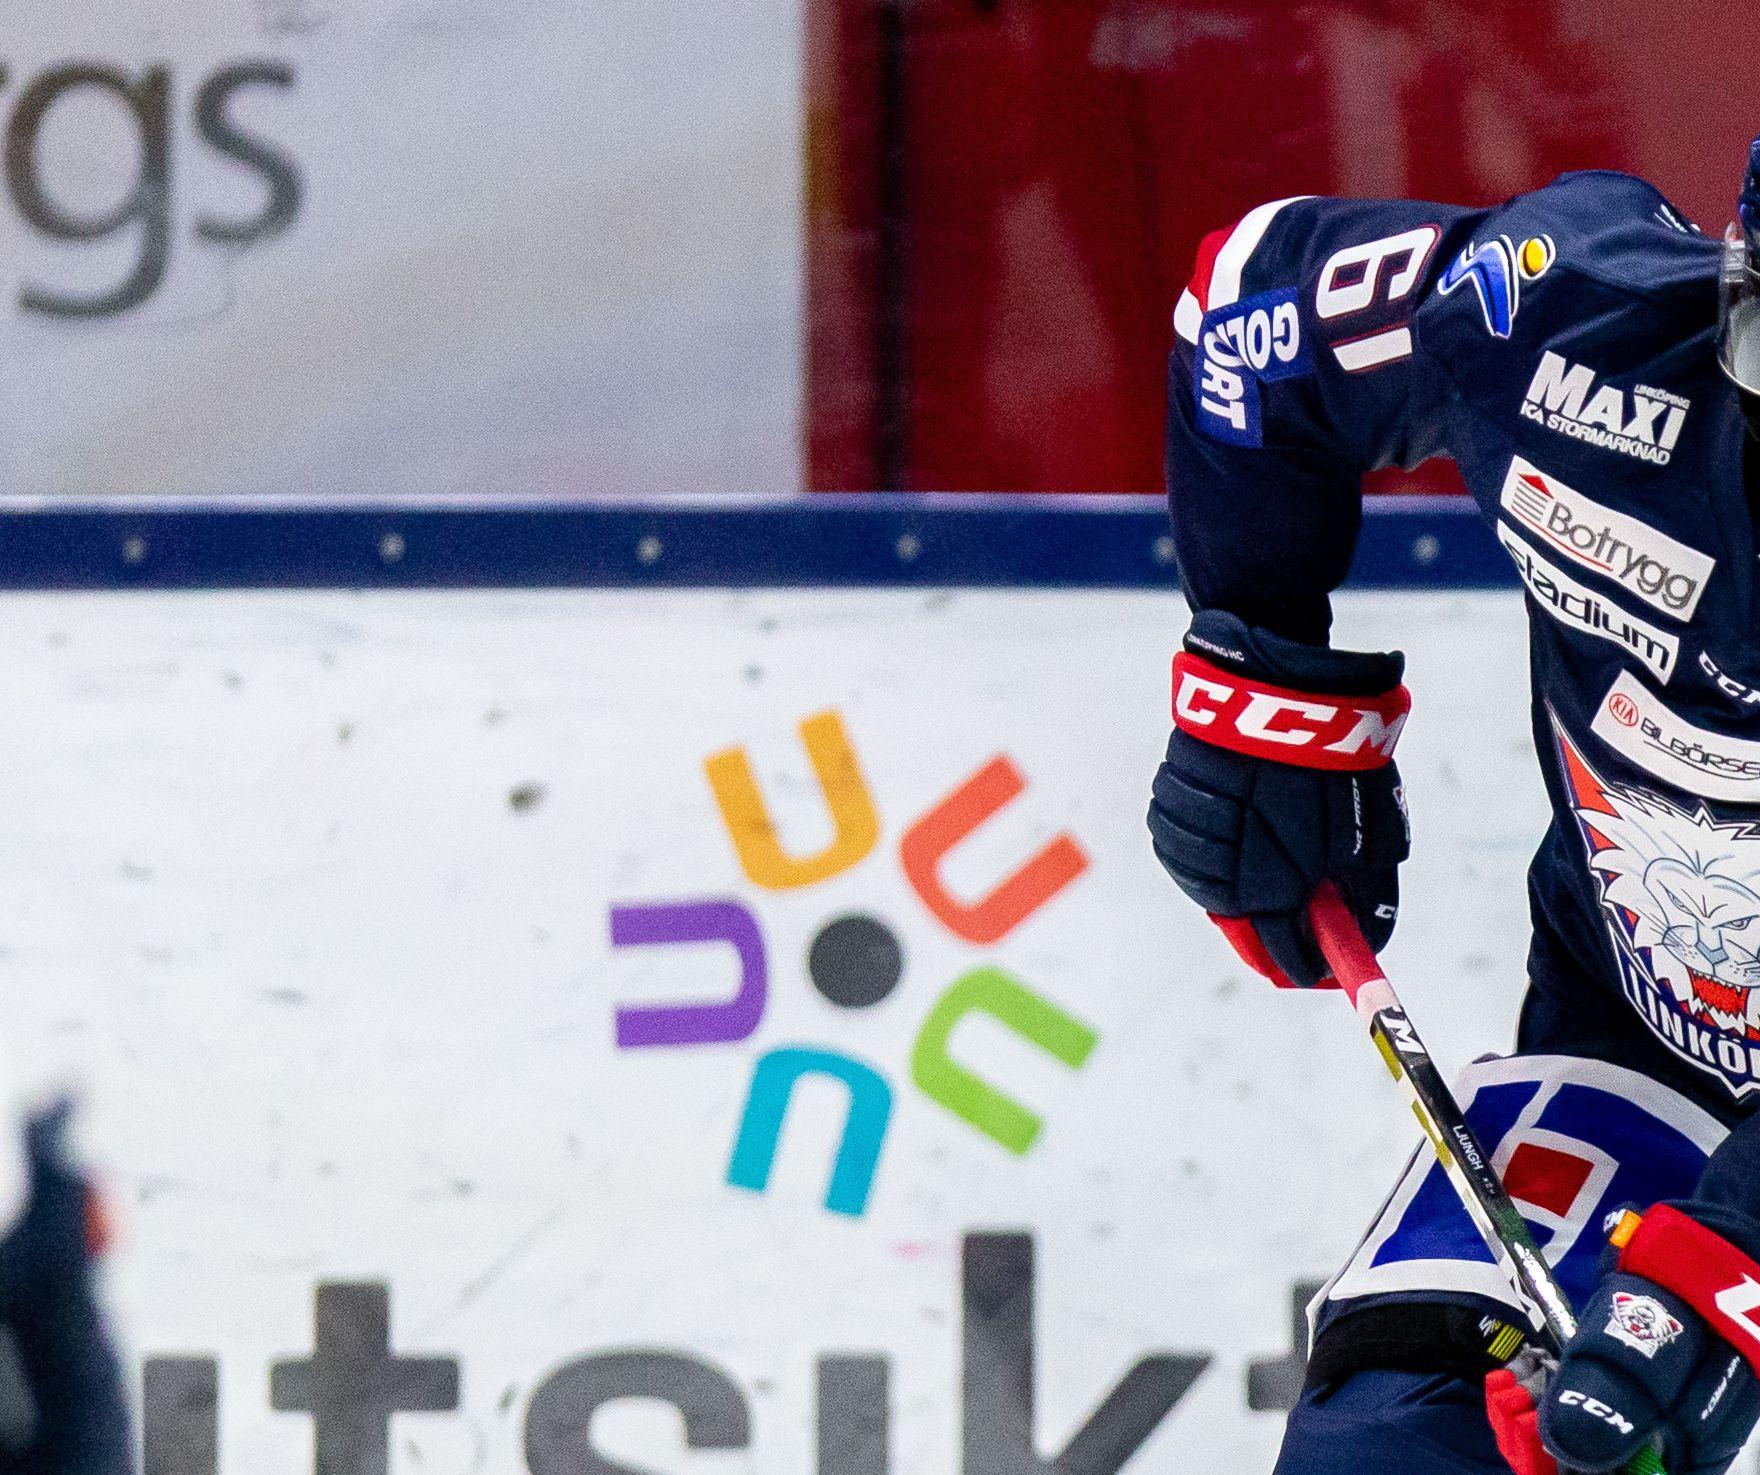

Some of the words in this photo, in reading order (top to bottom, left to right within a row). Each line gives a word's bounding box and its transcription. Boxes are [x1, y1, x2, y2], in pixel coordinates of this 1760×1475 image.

[0, 58, 306, 322] gs
[1313, 224, 1440, 373] 61
[1519, 399, 1545, 426] ICA
[1546, 413, 1672, 466] STORMARKNAD
[1525, 349, 1687, 451] MAXI
[1546, 500, 1698, 610] Botrygg
[1504, 538, 1671, 673] stadium
[1173, 672, 1408, 758] CCM
[1611, 696, 1637, 726] KIA
[1452, 1124, 1484, 1170] LJUNGH
[1558, 1389, 1635, 1434] CCM
